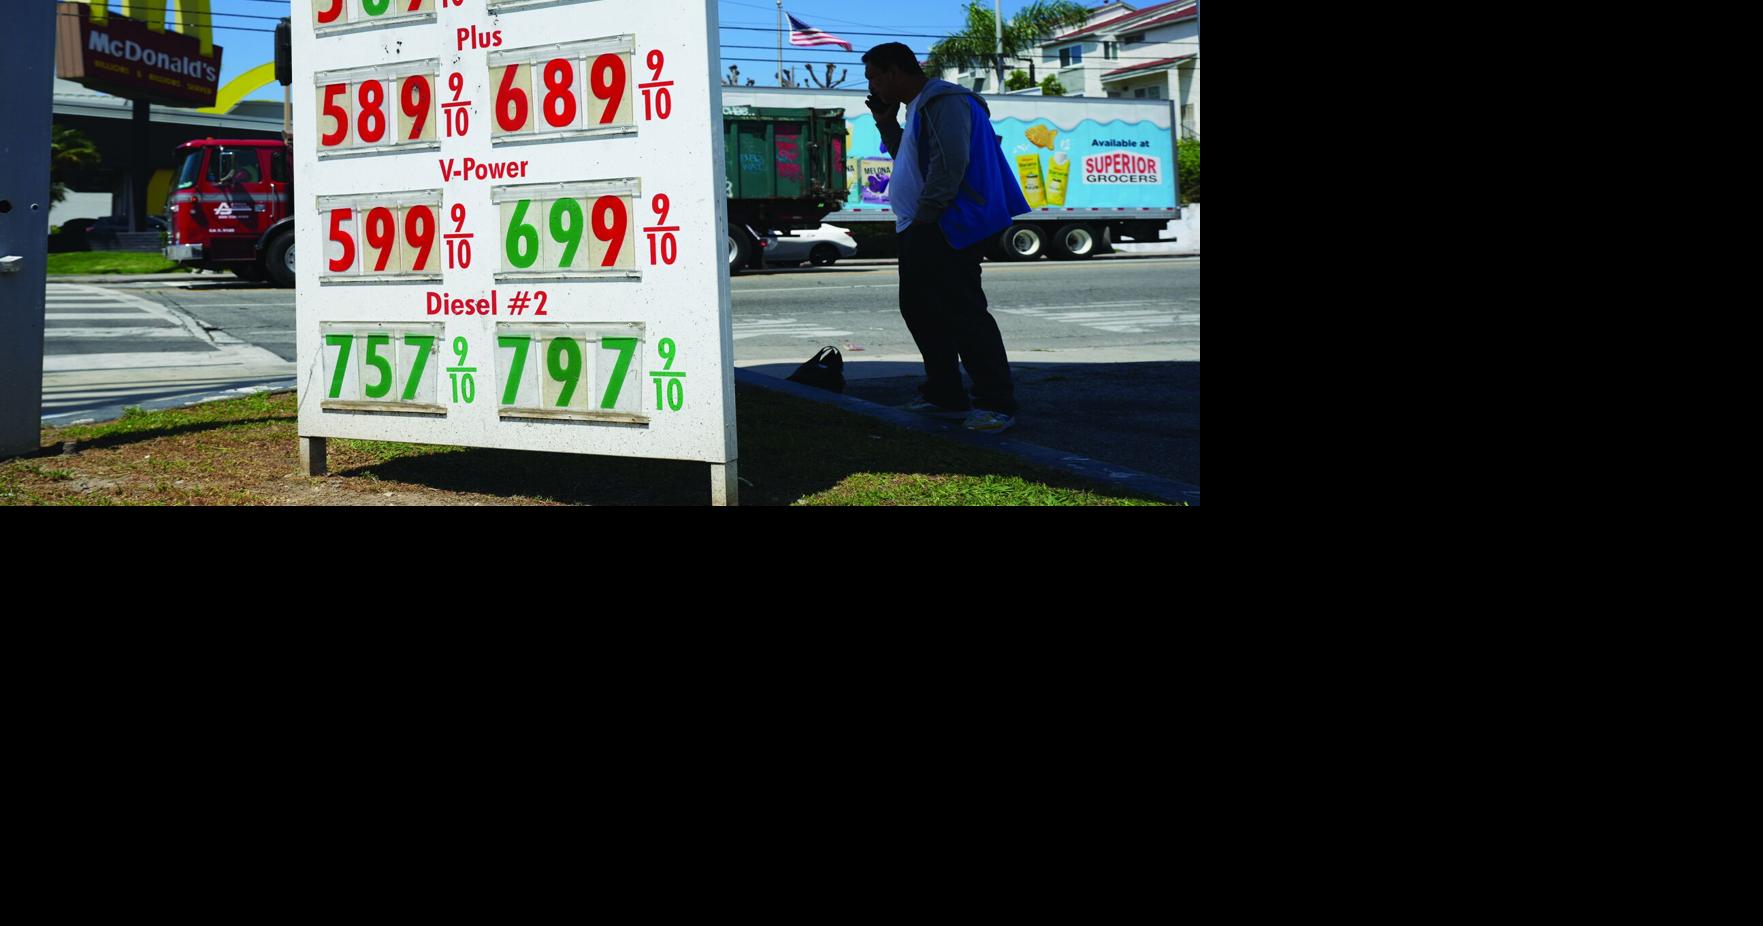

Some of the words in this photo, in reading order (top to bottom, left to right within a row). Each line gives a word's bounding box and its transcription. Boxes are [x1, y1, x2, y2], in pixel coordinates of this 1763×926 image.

[457, 26, 503, 50] Plus
[88, 30, 216, 82] McDonald's
[646, 49, 665, 82] 9
[448, 72, 464, 102] 9
[495, 52, 627, 133] 689
[321, 74, 432, 147] 589
[641, 87, 672, 121] 10
[443, 107, 470, 138] 10
[1091, 139, 1137, 147] Available
[1139, 140, 1150, 148] at
[438, 158, 528, 183] V-Power
[864, 166, 891, 175] MELONA
[1086, 153, 1157, 174] SUPERIOR
[1086, 174, 1158, 183] GROCERS
[450, 203, 467, 232] 9
[651, 193, 671, 225] 9
[328, 204, 436, 272] 599
[505, 195, 629, 269] 699
[446, 238, 472, 269] 10
[646, 232, 678, 266] 10
[426, 290, 498, 316] Diesel
[508, 290, 548, 316] #2
[325, 333, 436, 401] 757
[452, 336, 470, 367] 9
[657, 337, 677, 371] 9
[497, 335, 639, 410] 797
[449, 373, 476, 405] 10
[652, 378, 685, 412] 10
